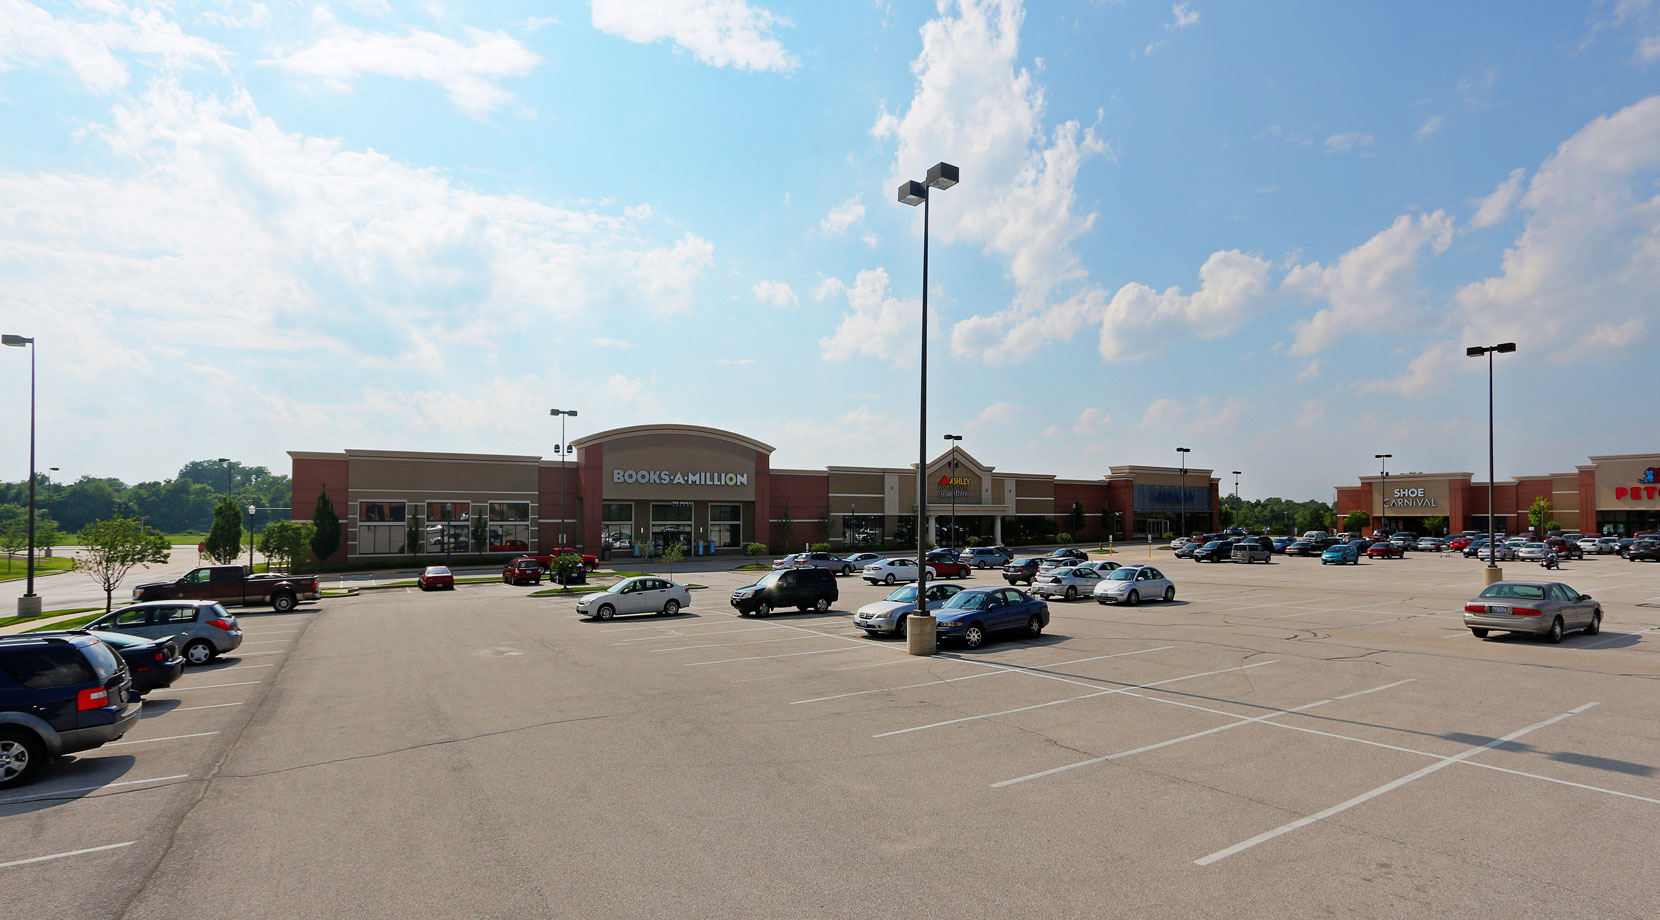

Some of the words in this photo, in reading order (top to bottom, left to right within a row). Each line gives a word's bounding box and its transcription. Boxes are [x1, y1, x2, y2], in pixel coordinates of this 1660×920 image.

[1394, 488, 1424, 497] SHOE
[1615, 486, 1660, 500] PET
[1384, 498, 1436, 508] CARNIVAL
